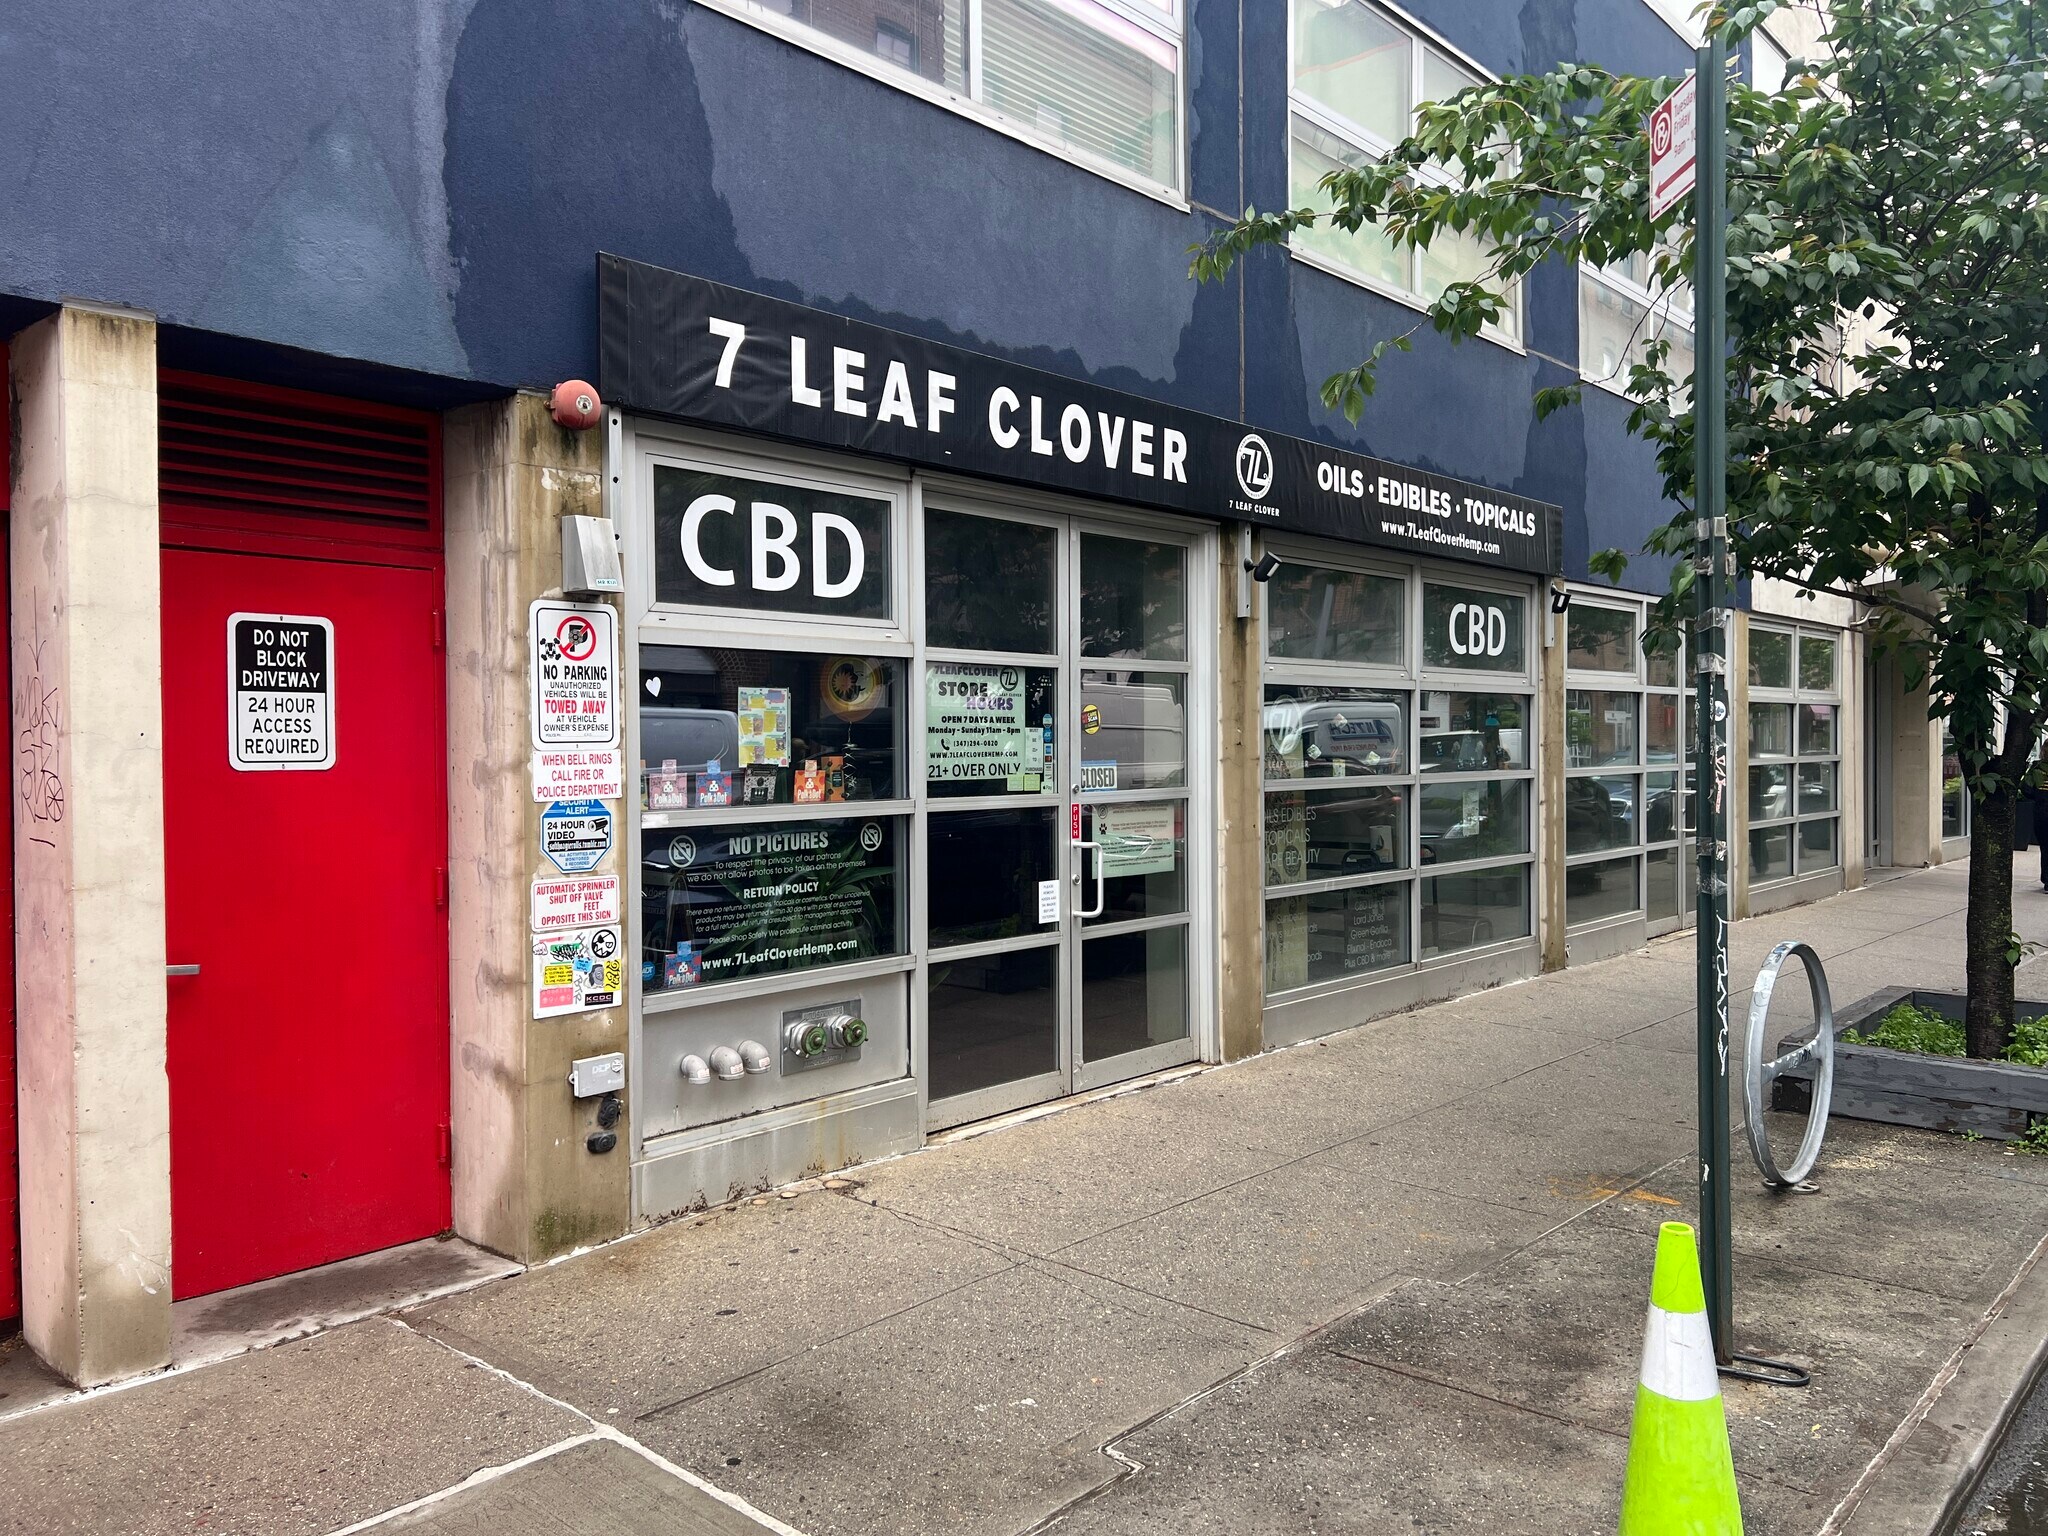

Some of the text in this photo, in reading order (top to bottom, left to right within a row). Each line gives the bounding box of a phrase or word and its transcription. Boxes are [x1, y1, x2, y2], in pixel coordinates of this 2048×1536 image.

[1674, 110, 1691, 135] Friday
[709, 316, 745, 389] 7
[790, 336, 956, 433] LEAF
[988, 386, 1188, 484] CLOVER
[1317, 461, 1364, 498] OILS
[1378, 476, 1451, 519] EDIBLES
[1464, 498, 1536, 537] TOPICALS
[1229, 500, 1280, 517] 7 LEAF CLOVER
[1381, 520, 1500, 555] www.7LeafCloverHemp.com
[680, 494, 865, 598] CBD
[1449, 603, 1506, 657] CBD
[254, 629, 310, 648] DO NOT
[256, 650, 307, 668] BLOCK
[242, 670, 320, 688] DRIVEWAY
[543, 665, 608, 681] NO PARKING
[935, 666, 999, 677] 7LEAFCLOVER
[550, 682, 602, 690] UNAUTHORIZED
[939, 682, 988, 697] STORE
[544, 690, 608, 699] VEHICLES WILL BE
[248, 697, 315, 714] 24 HOUR
[545, 700, 606, 714] TOWED AWAY
[966, 697, 1014, 711] HOURS
[252, 718, 312, 734] ACCESS
[556, 715, 597, 723] AT VEHICLE
[942, 716, 964, 724] OPEN
[964, 716, 969, 724] 7
[969, 716, 988, 724] DAYS
[544, 724, 609, 732] OWNER'S EXPENSE
[928, 727, 956, 736] Monday
[962, 727, 987, 736] Sunday
[1007, 727, 1021, 736] 8pm
[245, 739, 319, 755] REQUIRED
[542, 754, 613, 766] WHEN BELL RINGS
[551, 769, 604, 781] CALL FIRE OR
[929, 763, 1021, 778] 21+ OVER ONLY
[1081, 767, 1115, 789] CLOSED
[538, 784, 618, 798] POLICE DEPARTMENT
[565, 807, 589, 815] ALERT
[1281, 806, 1317, 823] EDIBLES
[547, 821, 585, 830] 24 HOUR
[548, 831, 575, 840] VIDEO
[1265, 828, 1311, 846] TOPICALS
[729, 832, 829, 856] NO PICTURES
[725, 860, 753, 869] respect
[768, 856, 794, 865] privacy
[816, 853, 841, 862] patrons
[1286, 849, 1321, 866] BEAUTY
[728, 870, 747, 879] allow
[749, 868, 774, 877] photos
[838, 860, 866, 869] premises
[537, 881, 615, 895] AUTOMATIC SPRINKLER
[744, 882, 819, 899] RETURN POLICY
[550, 891, 603, 905] SHUT OFF VALVE
[584, 902, 600, 911] FEET
[686, 909, 703, 917] There
[542, 911, 611, 926] OPPOSITE THIS SIGN
[695, 915, 722, 925] products
[1353, 913, 1385, 926] Lord Jones
[709, 936, 731, 945] Please
[731, 933, 748, 942] Shop
[780, 926, 810, 936] prosecute
[810, 923, 832, 932] criminal
[711, 923, 720, 931] full
[1351, 924, 1389, 940] Green Gorilla
[702, 940, 858, 970] www.7LeafCloverHemp.com
[1344, 958, 1356, 969] Plus
[1356, 954, 1370, 966] CBD
[1370, 954, 1375, 963] &
